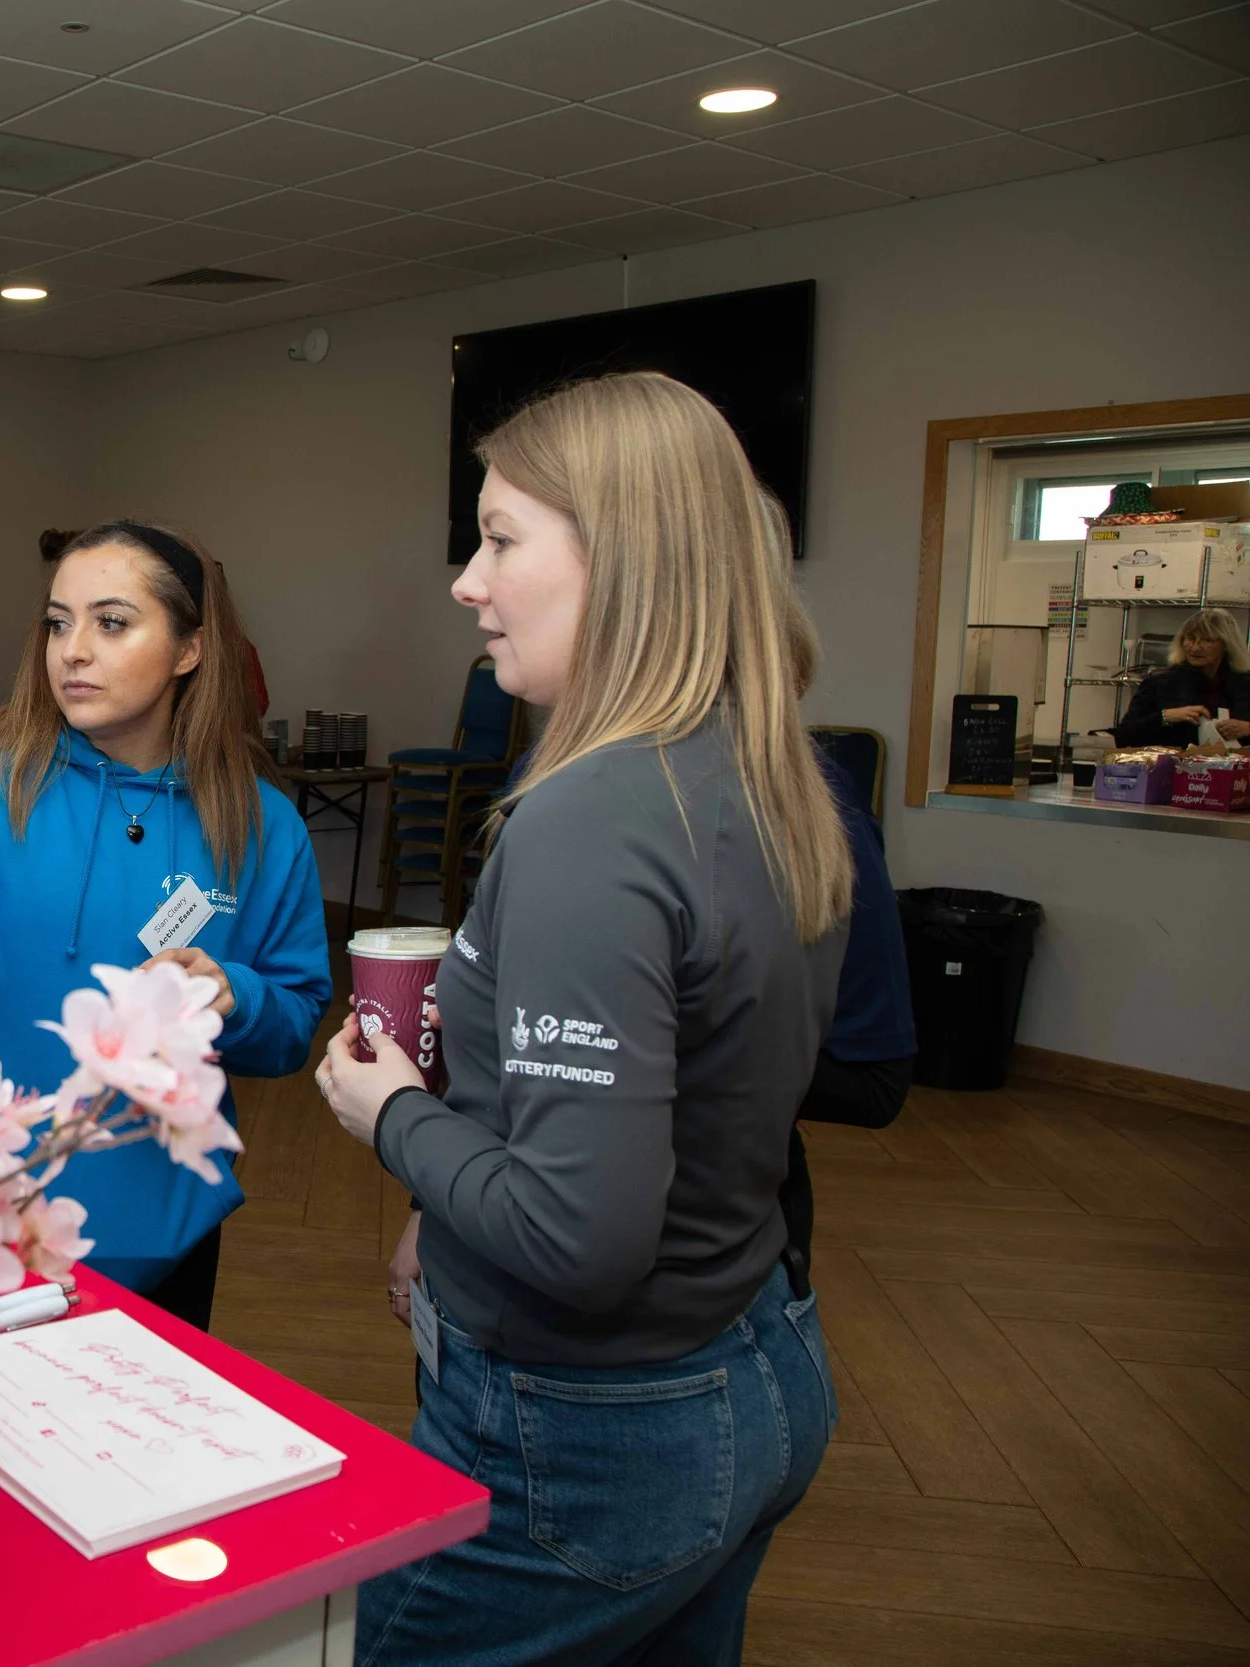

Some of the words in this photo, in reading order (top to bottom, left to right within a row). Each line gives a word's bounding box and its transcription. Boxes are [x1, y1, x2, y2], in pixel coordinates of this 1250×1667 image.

[154, 918, 169, 934] Sian
[167, 896, 188, 918] Cleary
[158, 923, 180, 948] Active
[178, 902, 198, 924] Essex
[370, 999, 392, 1019] ITALIA
[561, 1031, 619, 1050] ENGLAND
[562, 1018, 604, 1035] SPORT
[78, 1342, 151, 1376] Pretty
[144, 1375, 245, 1419] Perfect
